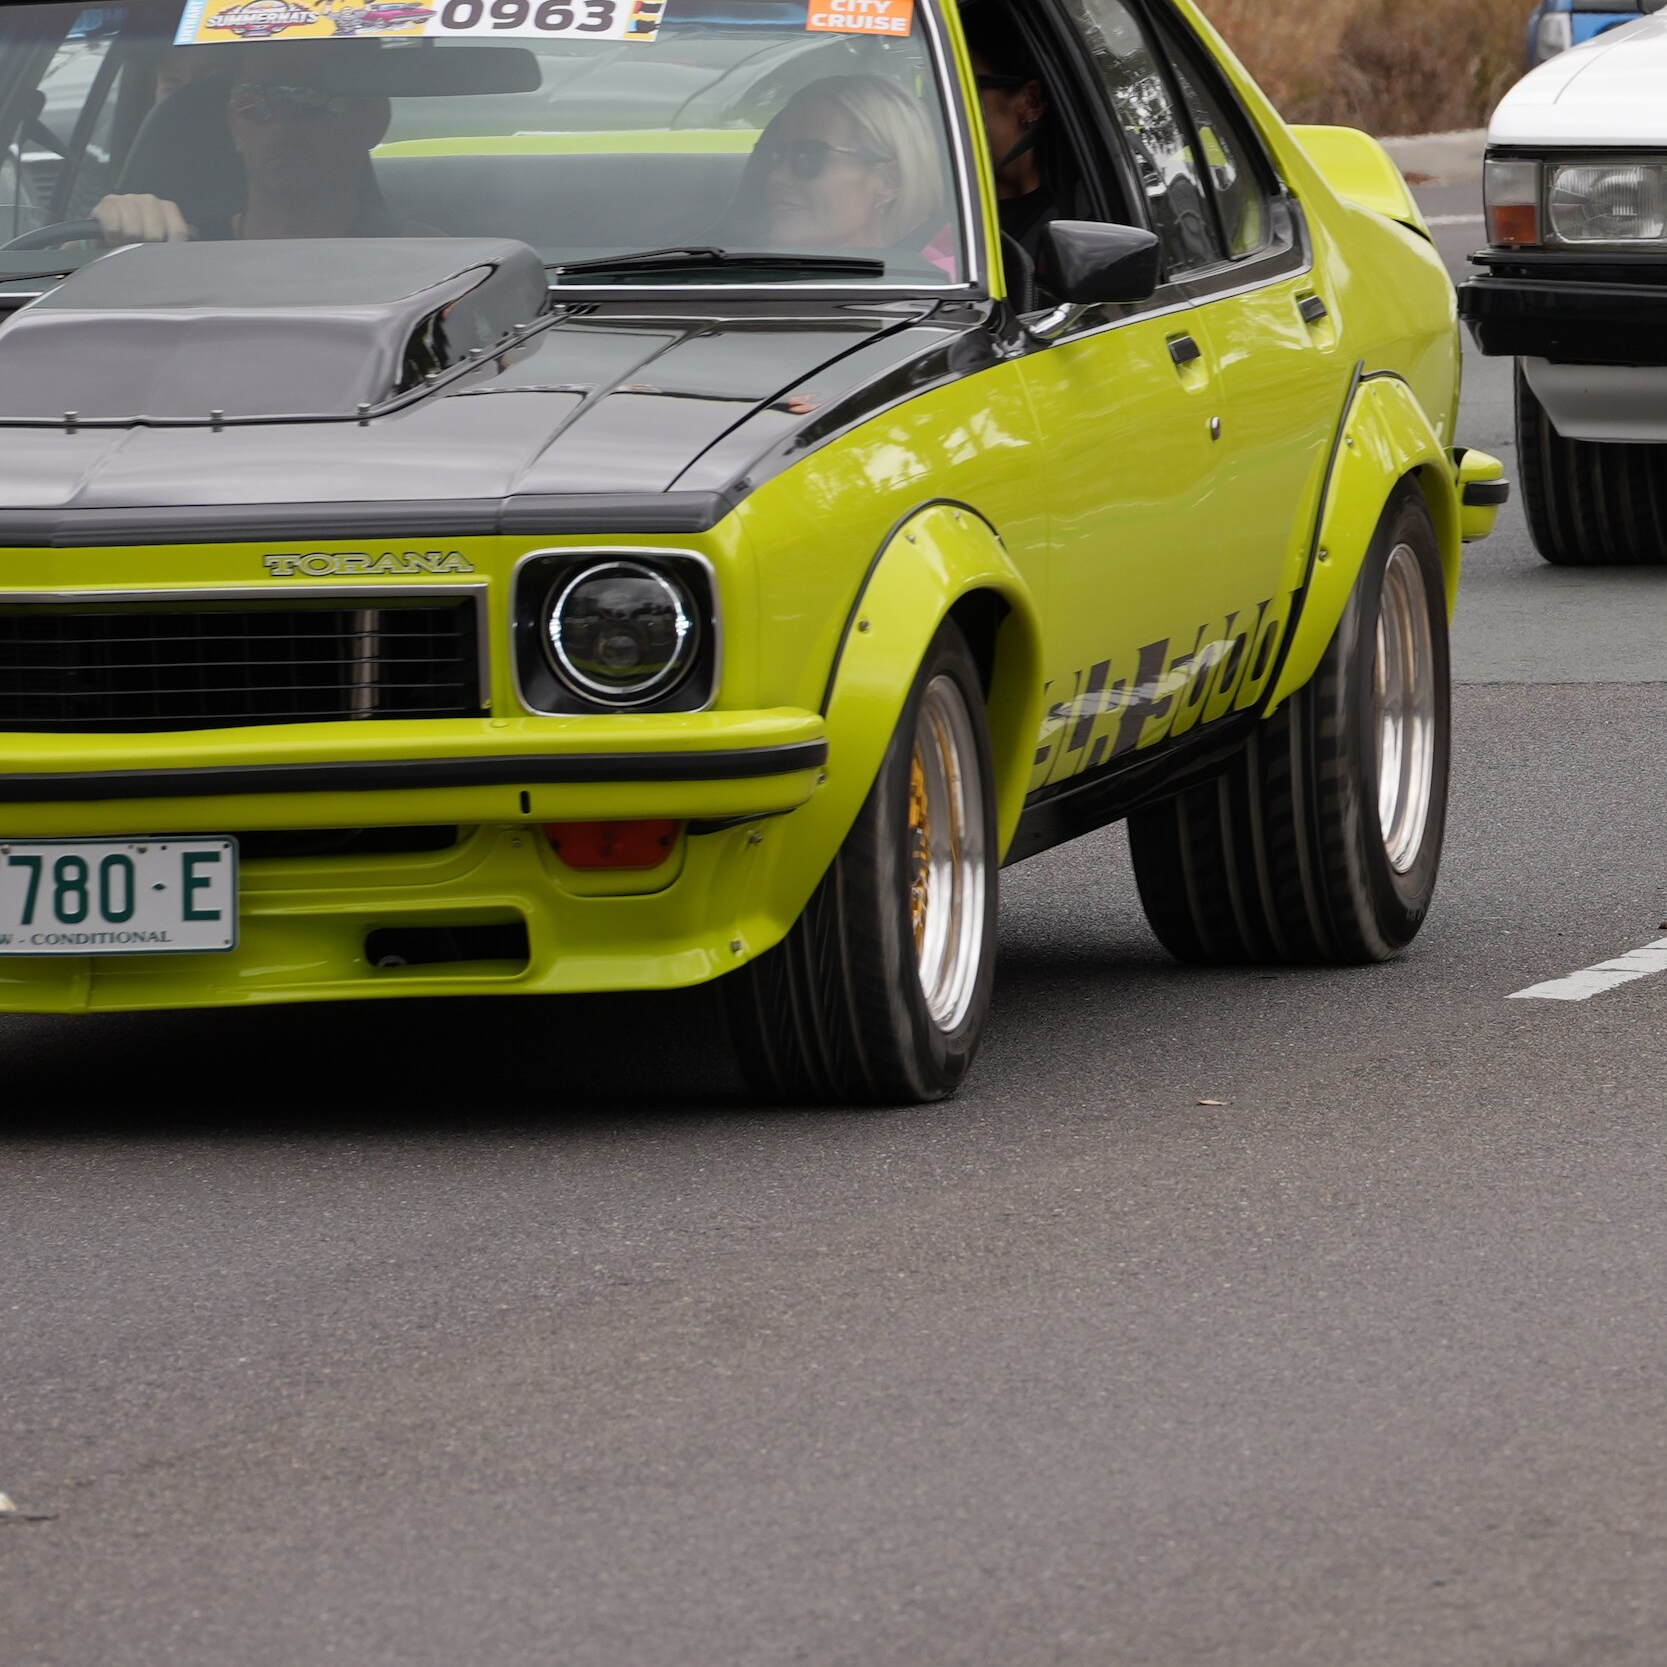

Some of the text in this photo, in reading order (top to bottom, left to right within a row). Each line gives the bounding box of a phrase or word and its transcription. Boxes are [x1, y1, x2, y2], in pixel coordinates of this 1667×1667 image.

[206, 11, 319, 28] SUMMERNATS
[811, 13, 907, 31] CRUISE
[263, 551, 475, 577] TORANA
[31, 931, 172, 946] CONDITIONAL
